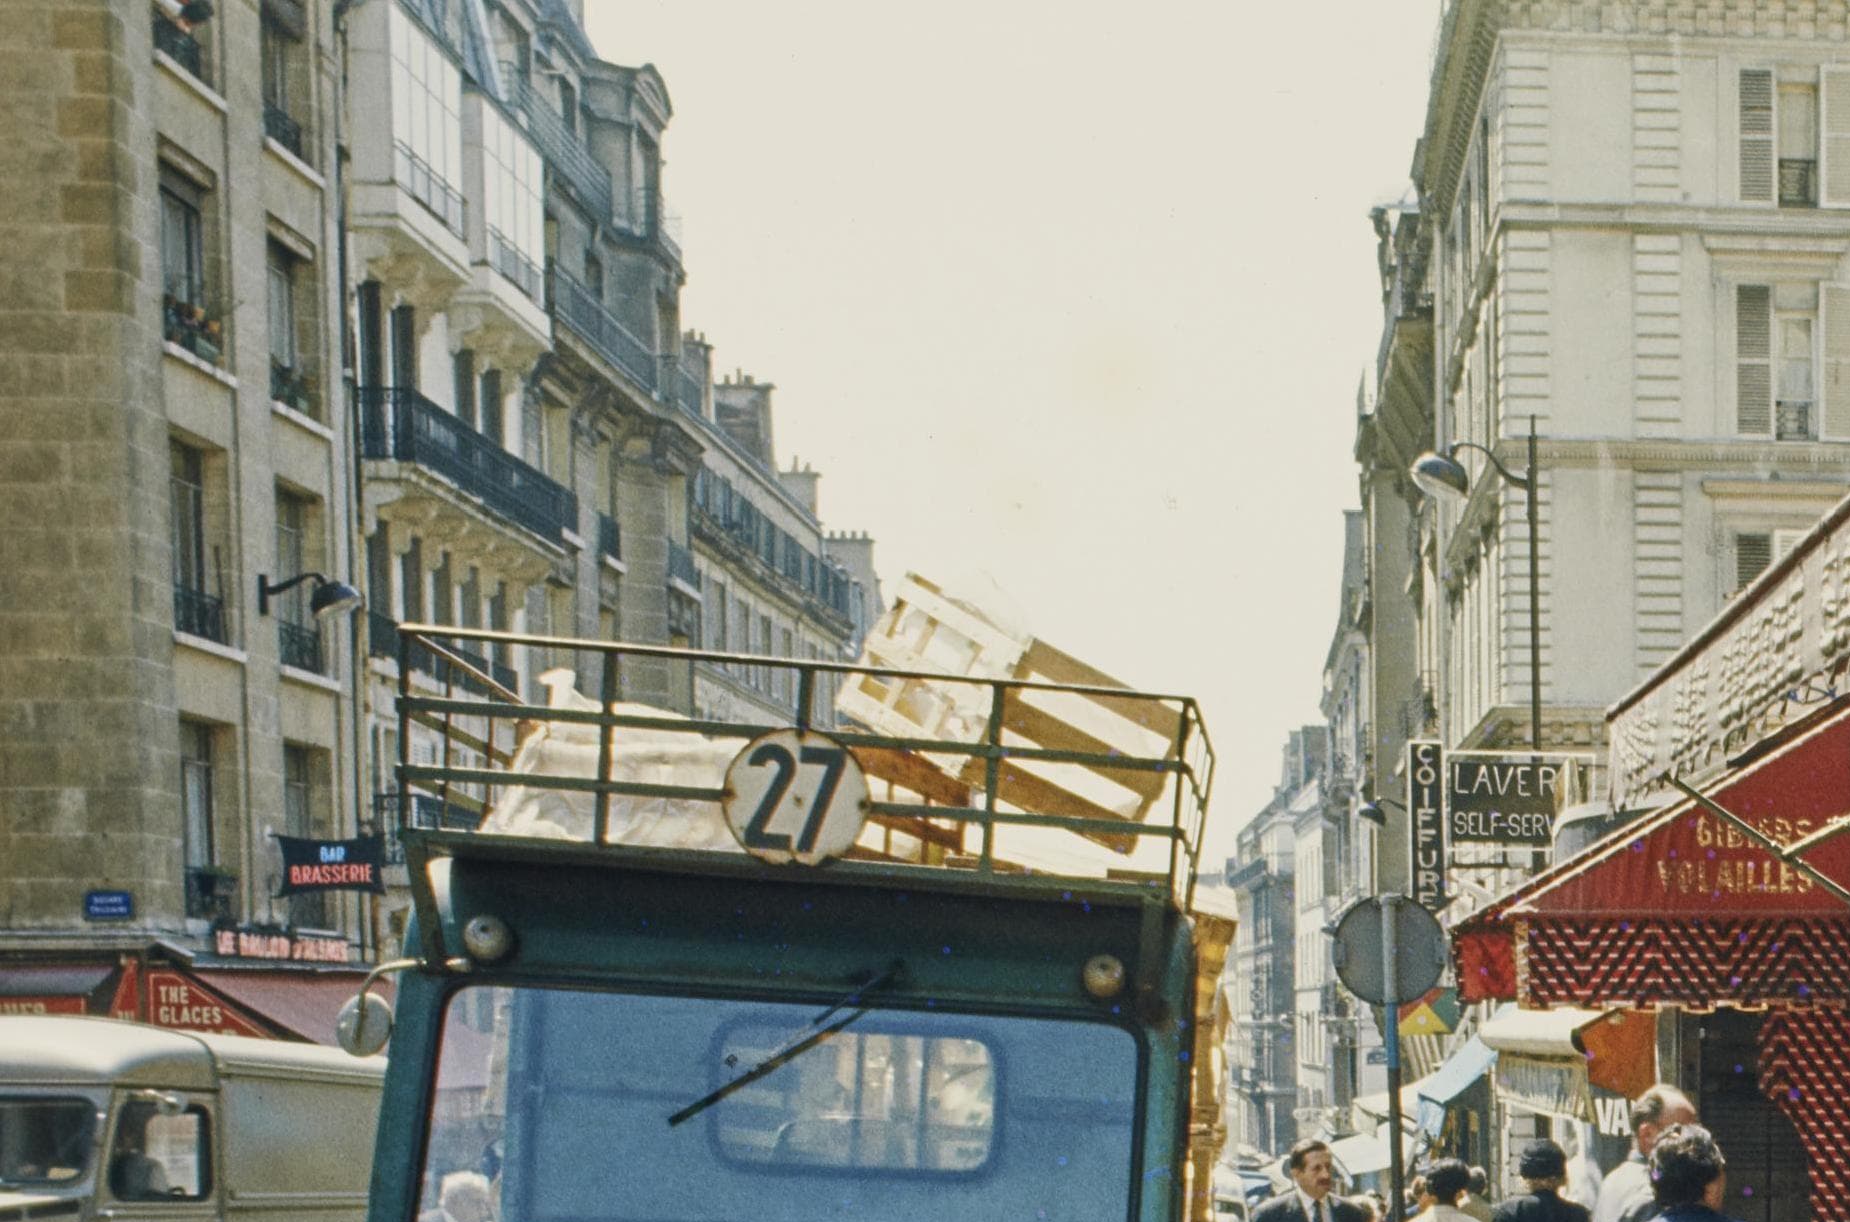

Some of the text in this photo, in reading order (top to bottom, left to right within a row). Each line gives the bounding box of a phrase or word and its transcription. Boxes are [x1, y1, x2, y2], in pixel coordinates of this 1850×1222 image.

[1454, 764, 1557, 797] LAVER
[745, 744, 847, 853] 27
[1416, 745, 1440, 910] COIFFURE
[320, 846, 346, 862] BAR
[290, 864, 373, 885] BRASSERIE
[1657, 859, 1813, 893] VOLAILLES
[159, 986, 189, 1005] THE
[159, 1007, 223, 1025] GLACES
[1595, 1098, 1632, 1136] VA
